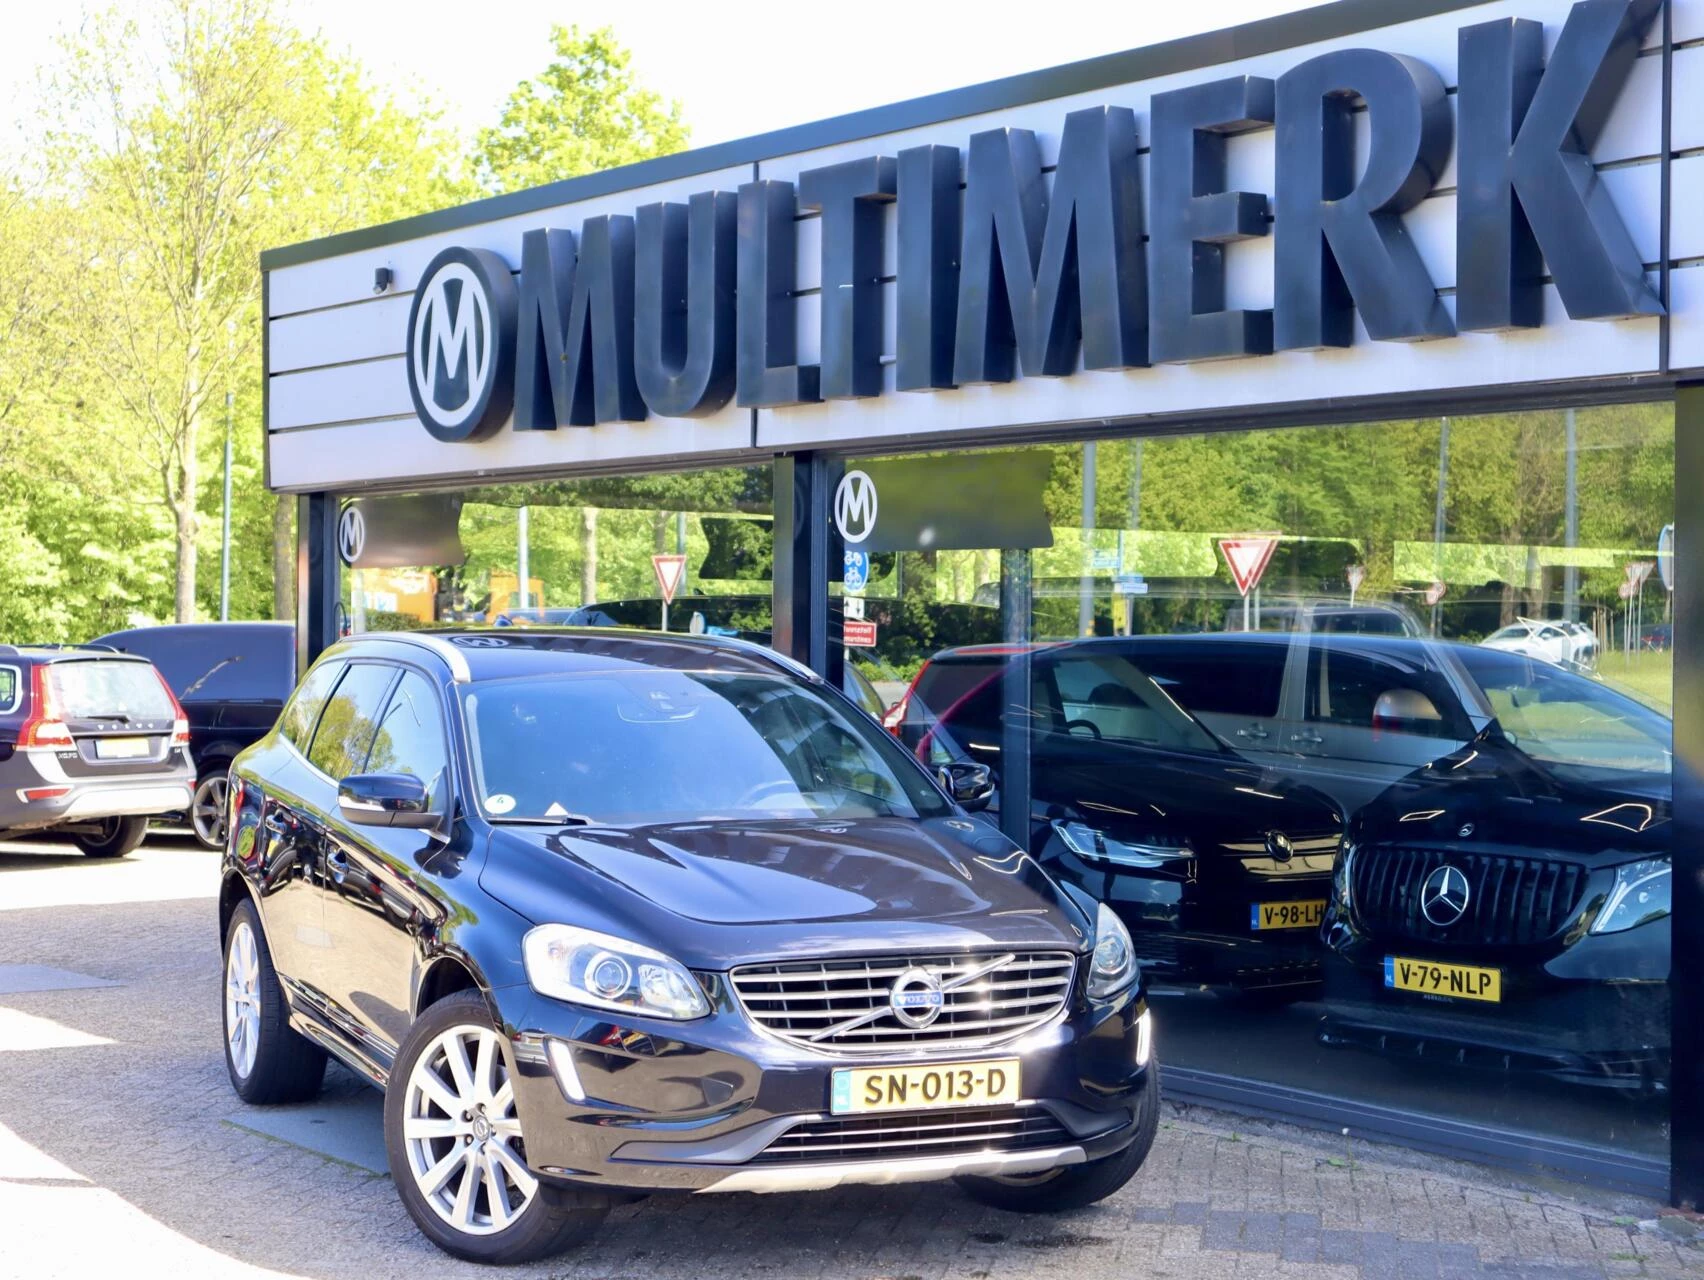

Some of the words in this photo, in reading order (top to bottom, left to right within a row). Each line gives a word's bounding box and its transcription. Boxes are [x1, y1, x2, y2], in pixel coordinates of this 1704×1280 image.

[513, 0, 1667, 432] MULTIMERK
[1400, 962, 1492, 996] V-79-NLP
[896, 993, 941, 1006] VOLVO
[864, 1067, 1006, 1105] SN-013-D
